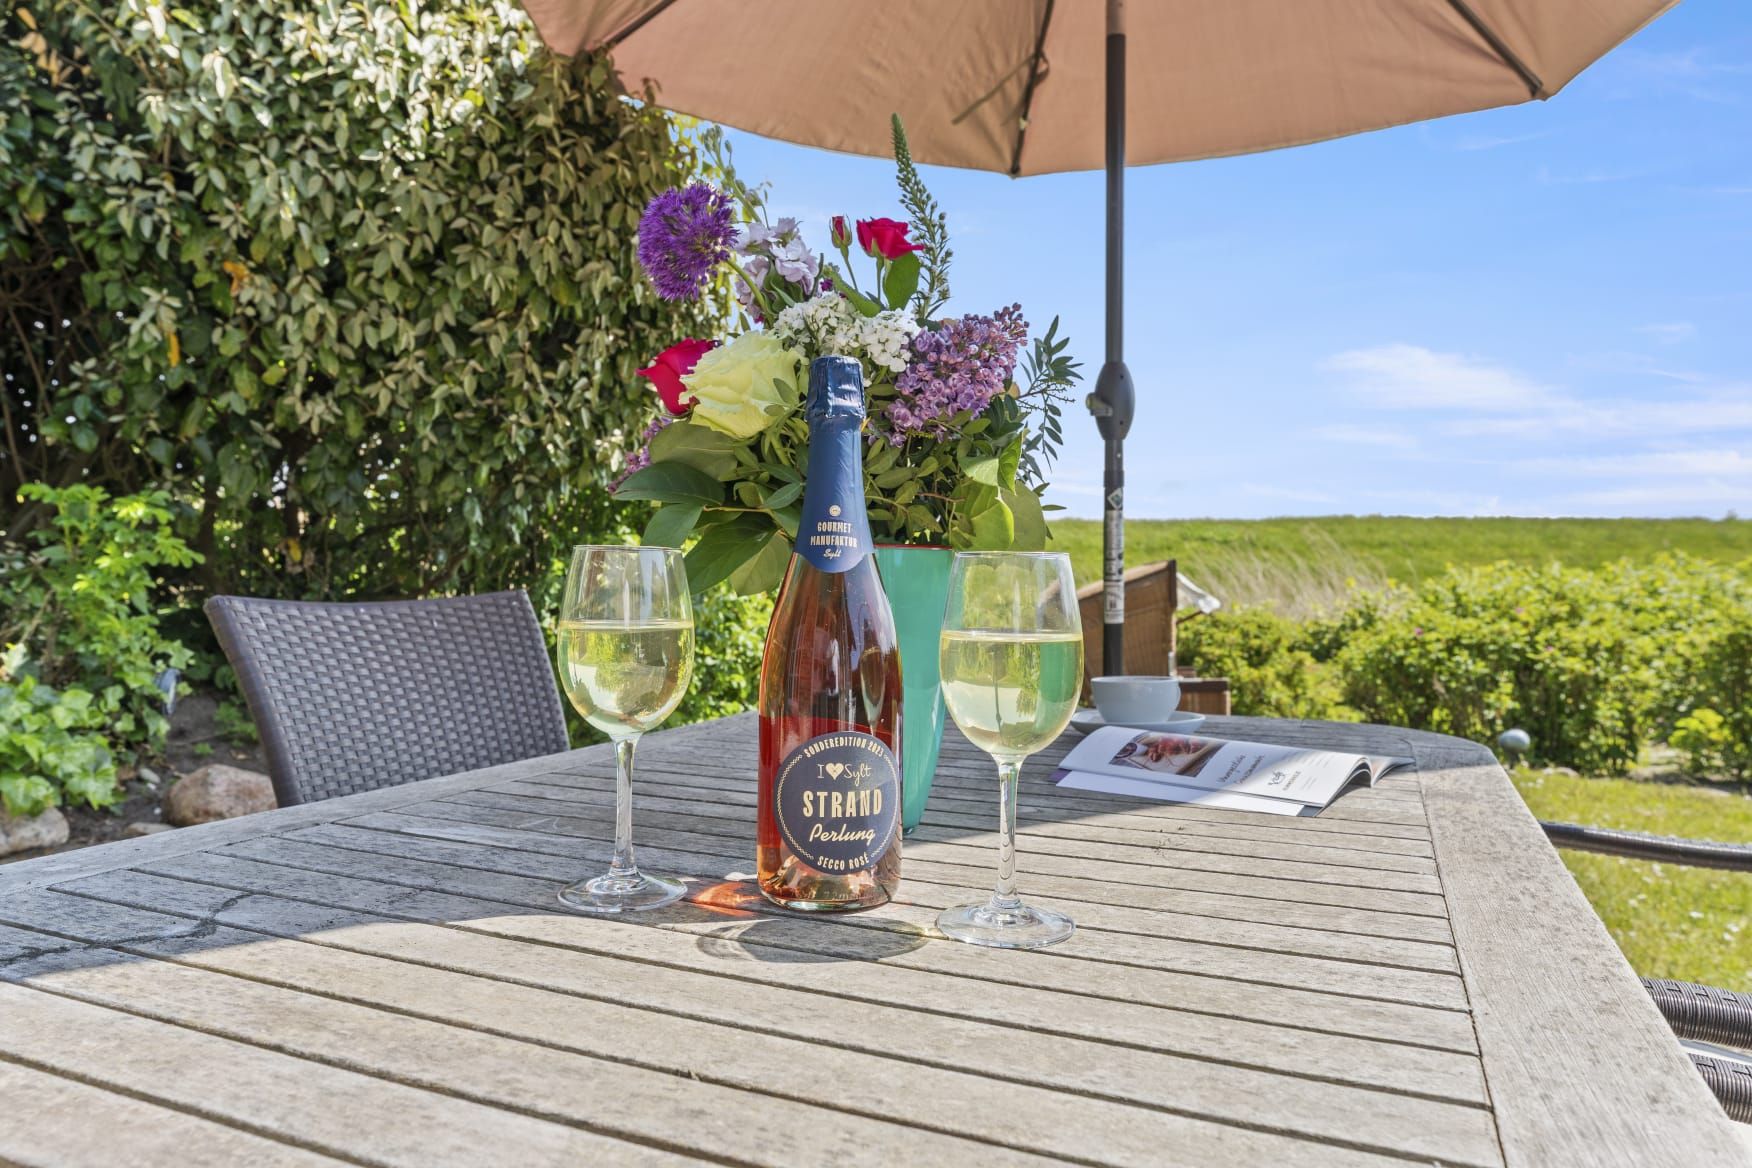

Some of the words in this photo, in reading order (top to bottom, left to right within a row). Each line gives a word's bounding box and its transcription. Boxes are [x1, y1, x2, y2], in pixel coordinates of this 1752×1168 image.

[818, 521, 851, 533] GOURMET
[810, 536, 857, 548] MANUFAKTUR
[823, 548, 842, 560] Sylt
[803, 736, 868, 758] SONDEREDITION
[843, 763, 872, 786] Sylt
[802, 789, 882, 818] STRAND
[809, 823, 876, 846] Perlung
[817, 855, 846, 871] SECCO
